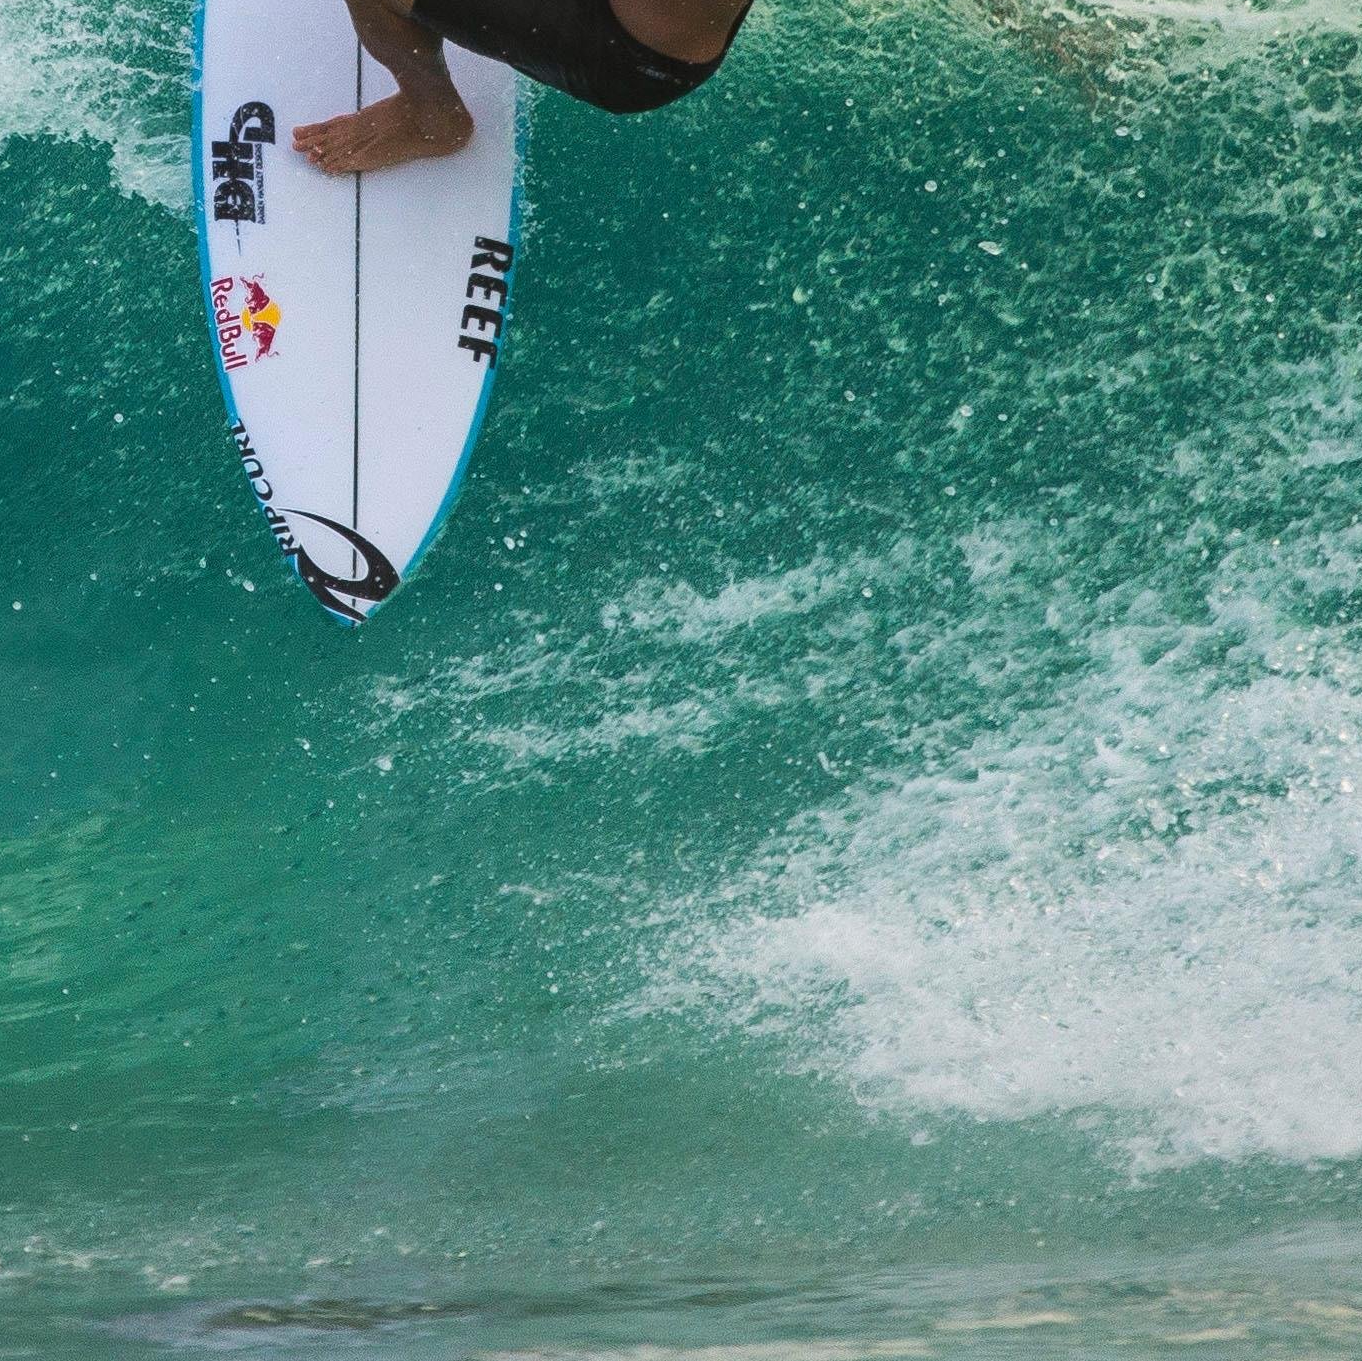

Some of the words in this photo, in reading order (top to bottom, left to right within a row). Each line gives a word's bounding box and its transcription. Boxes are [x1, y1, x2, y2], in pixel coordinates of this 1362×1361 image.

[211, 277, 240, 324] Red
[458, 235, 514, 370] REEF
[219, 324, 248, 371] Bull
[231, 417, 273, 501] CURL
[263, 506, 301, 556] RIP
